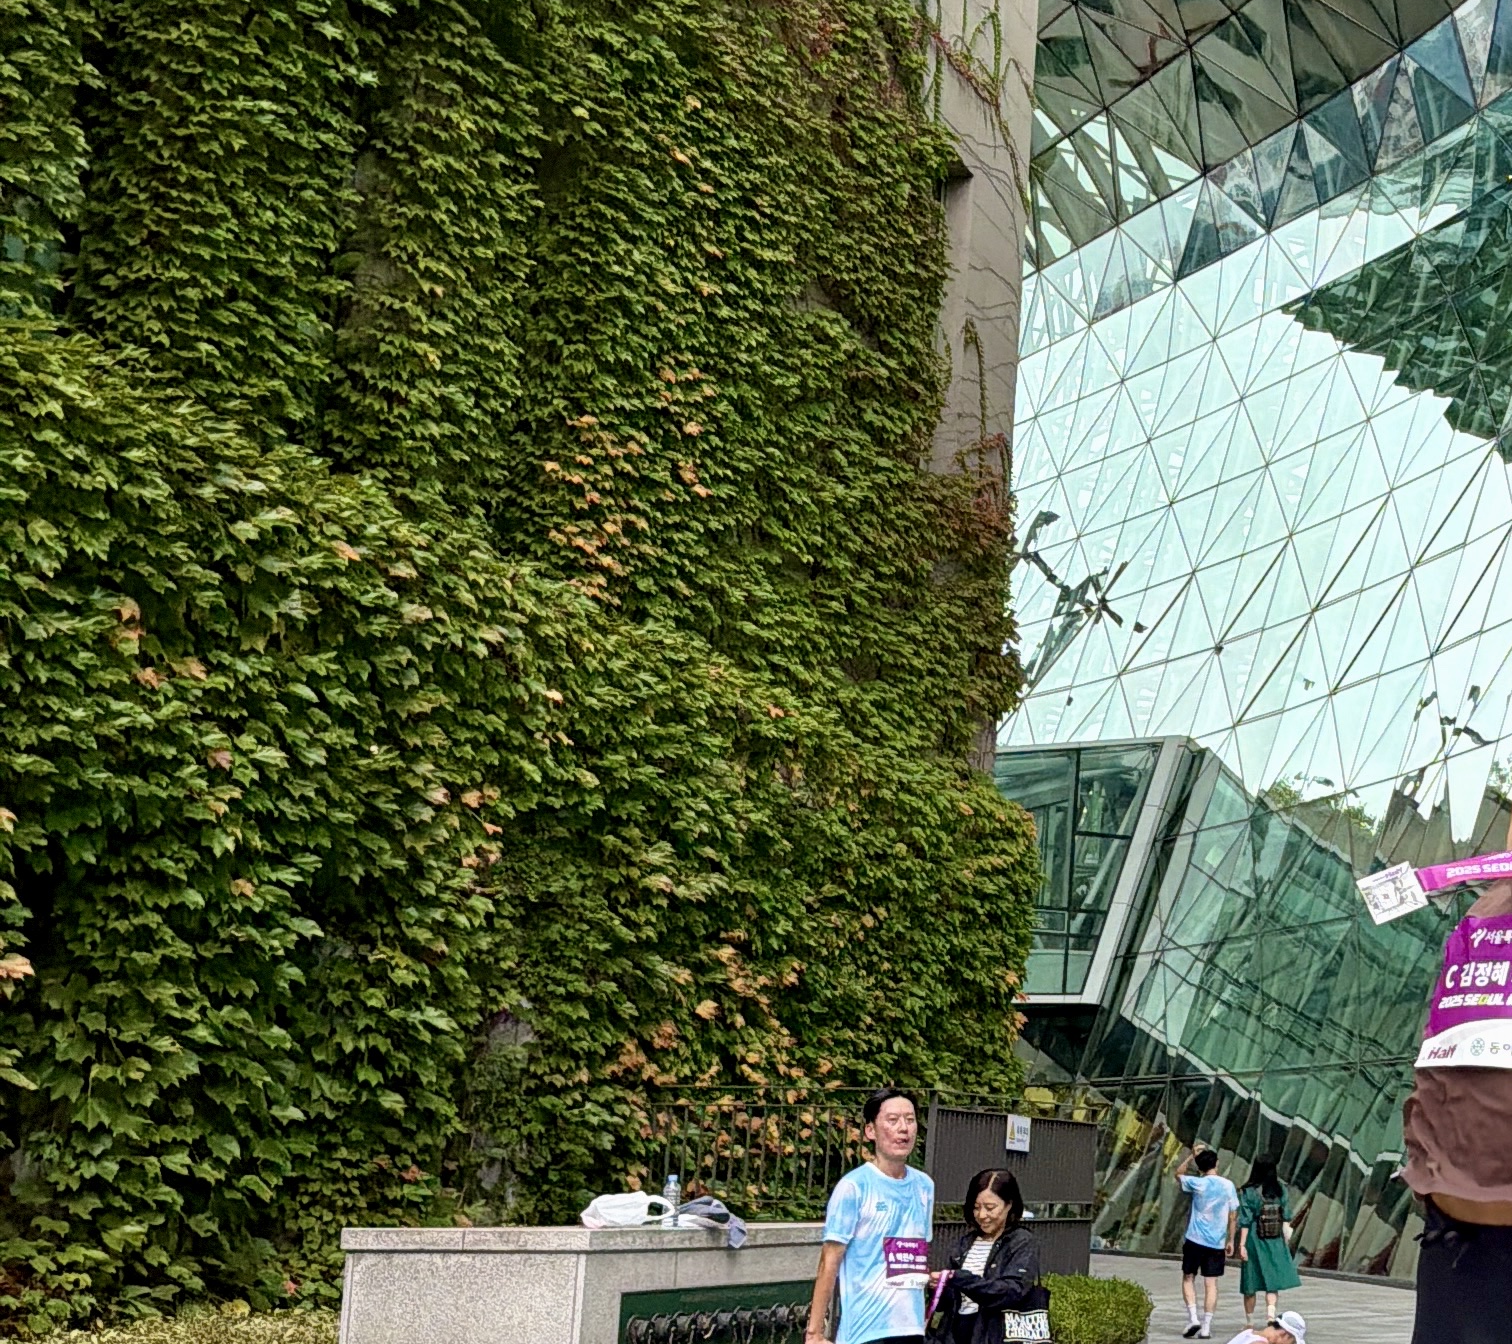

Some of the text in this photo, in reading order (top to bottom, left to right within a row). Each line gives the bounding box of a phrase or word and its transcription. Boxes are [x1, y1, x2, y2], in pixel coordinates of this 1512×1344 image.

[1446, 865, 1481, 879] 2025
[1445, 964, 1458, 989] C
[1460, 961, 1510, 987] 김정혜
[1438, 996, 1464, 1009] 2025
[1463, 993, 1504, 1006] SEOUL
